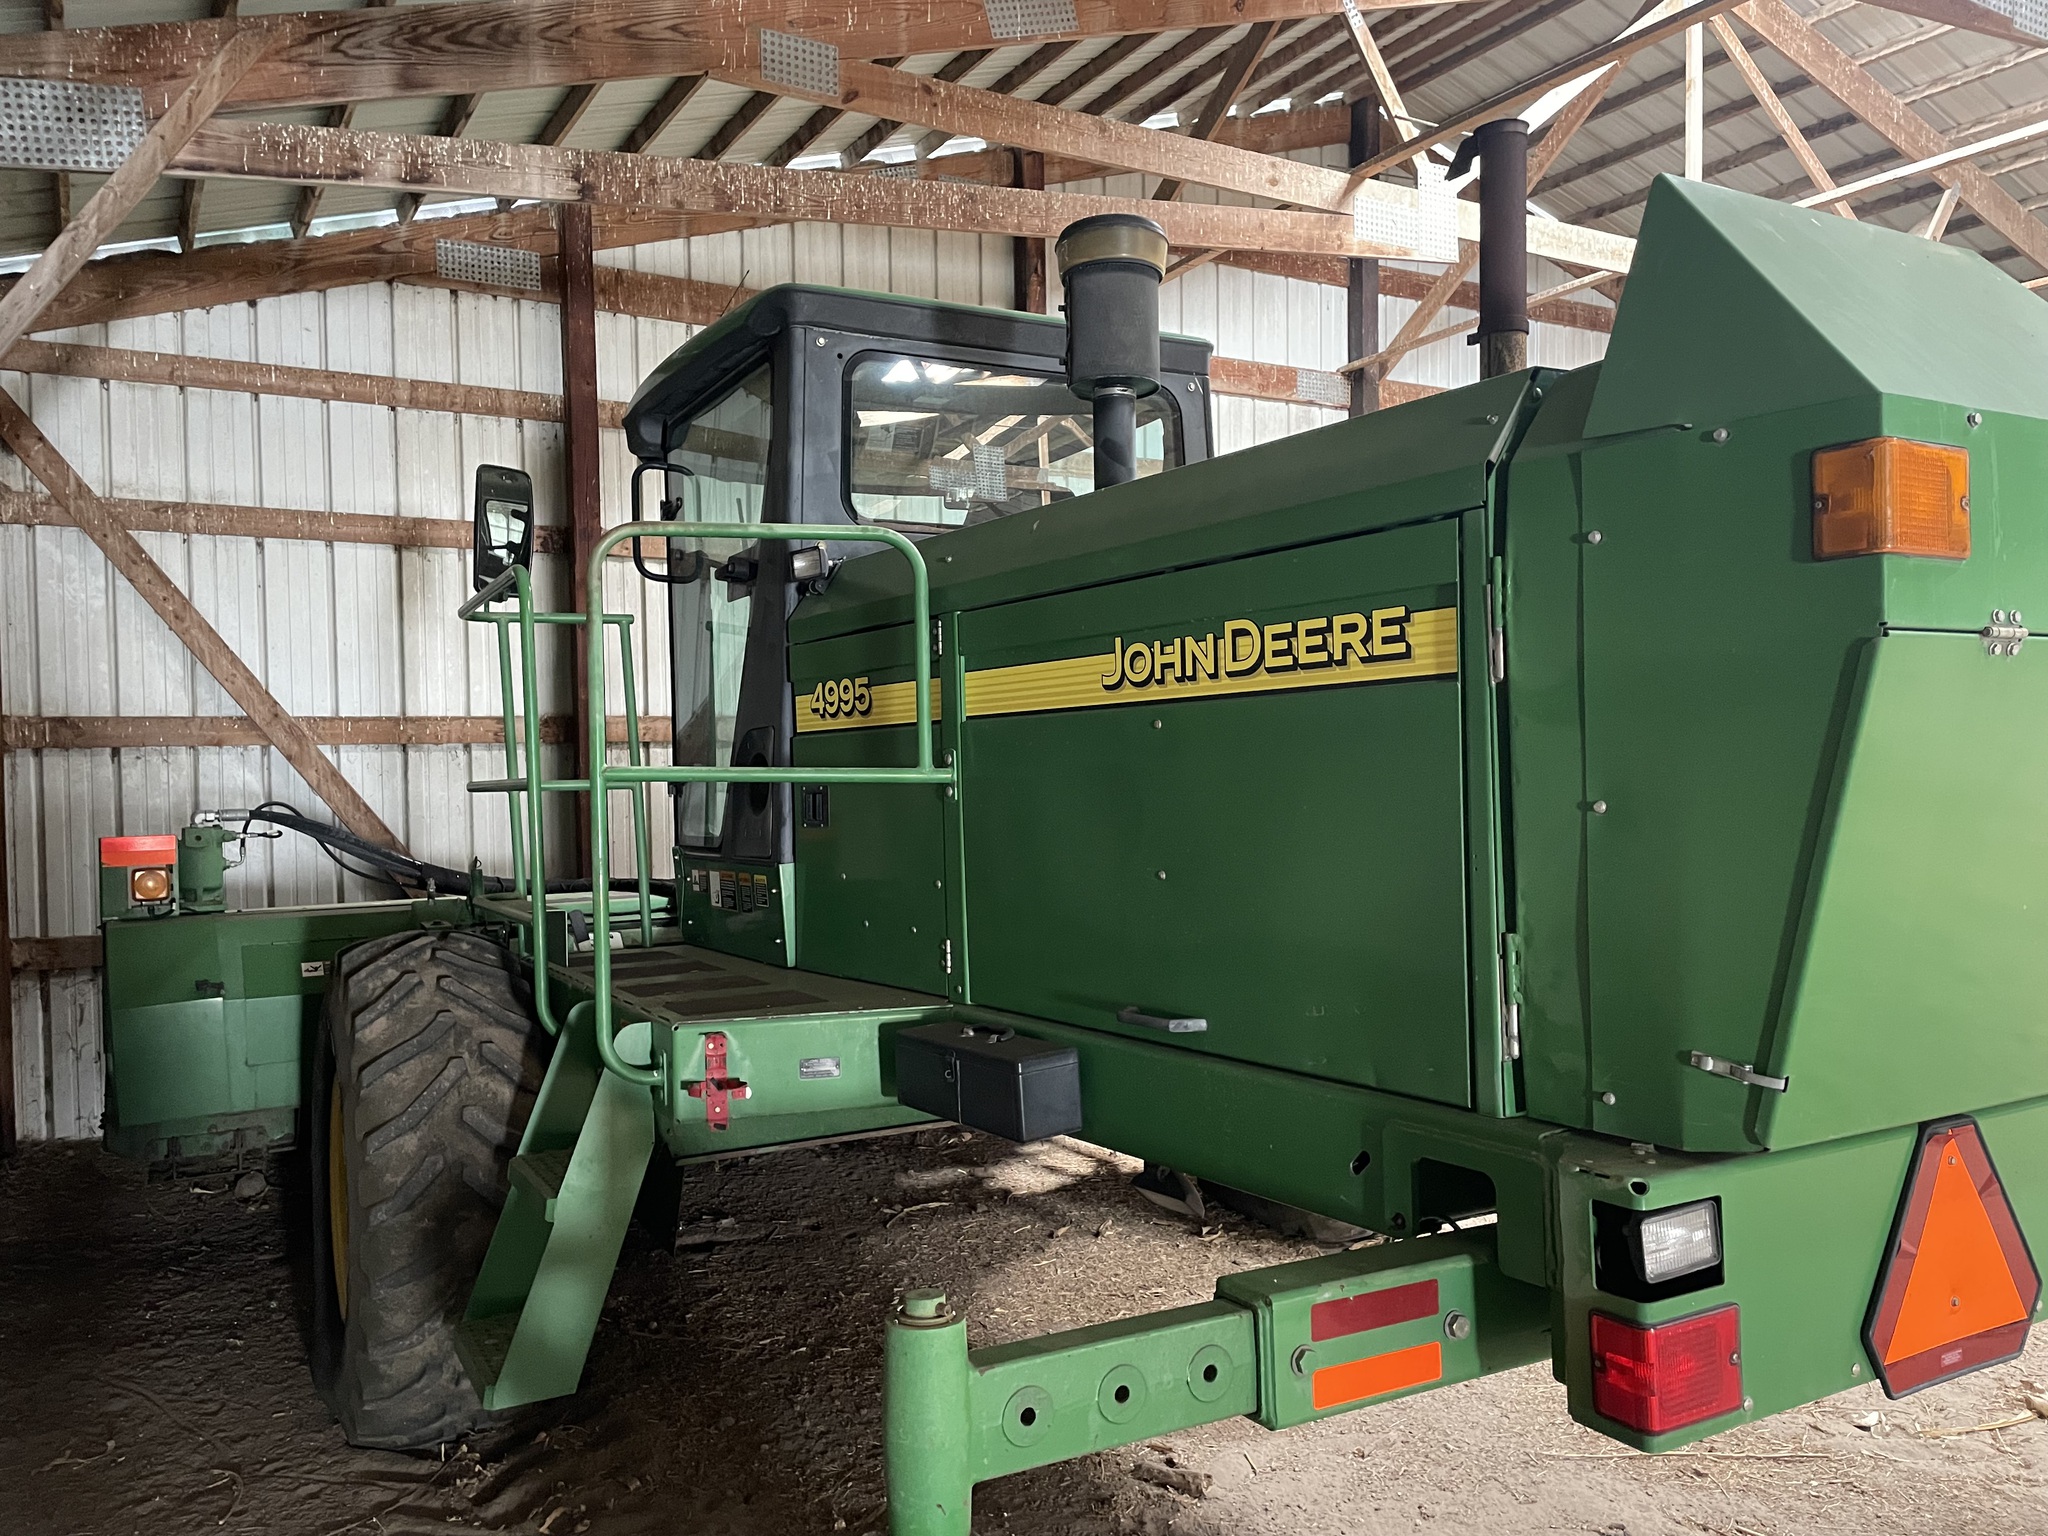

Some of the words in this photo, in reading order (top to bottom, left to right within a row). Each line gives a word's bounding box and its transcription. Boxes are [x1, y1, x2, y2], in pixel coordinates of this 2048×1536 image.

[1101, 632, 1221, 691] JOHN
[1223, 605, 1412, 678] DEERE
[810, 676, 872, 719] 4995
